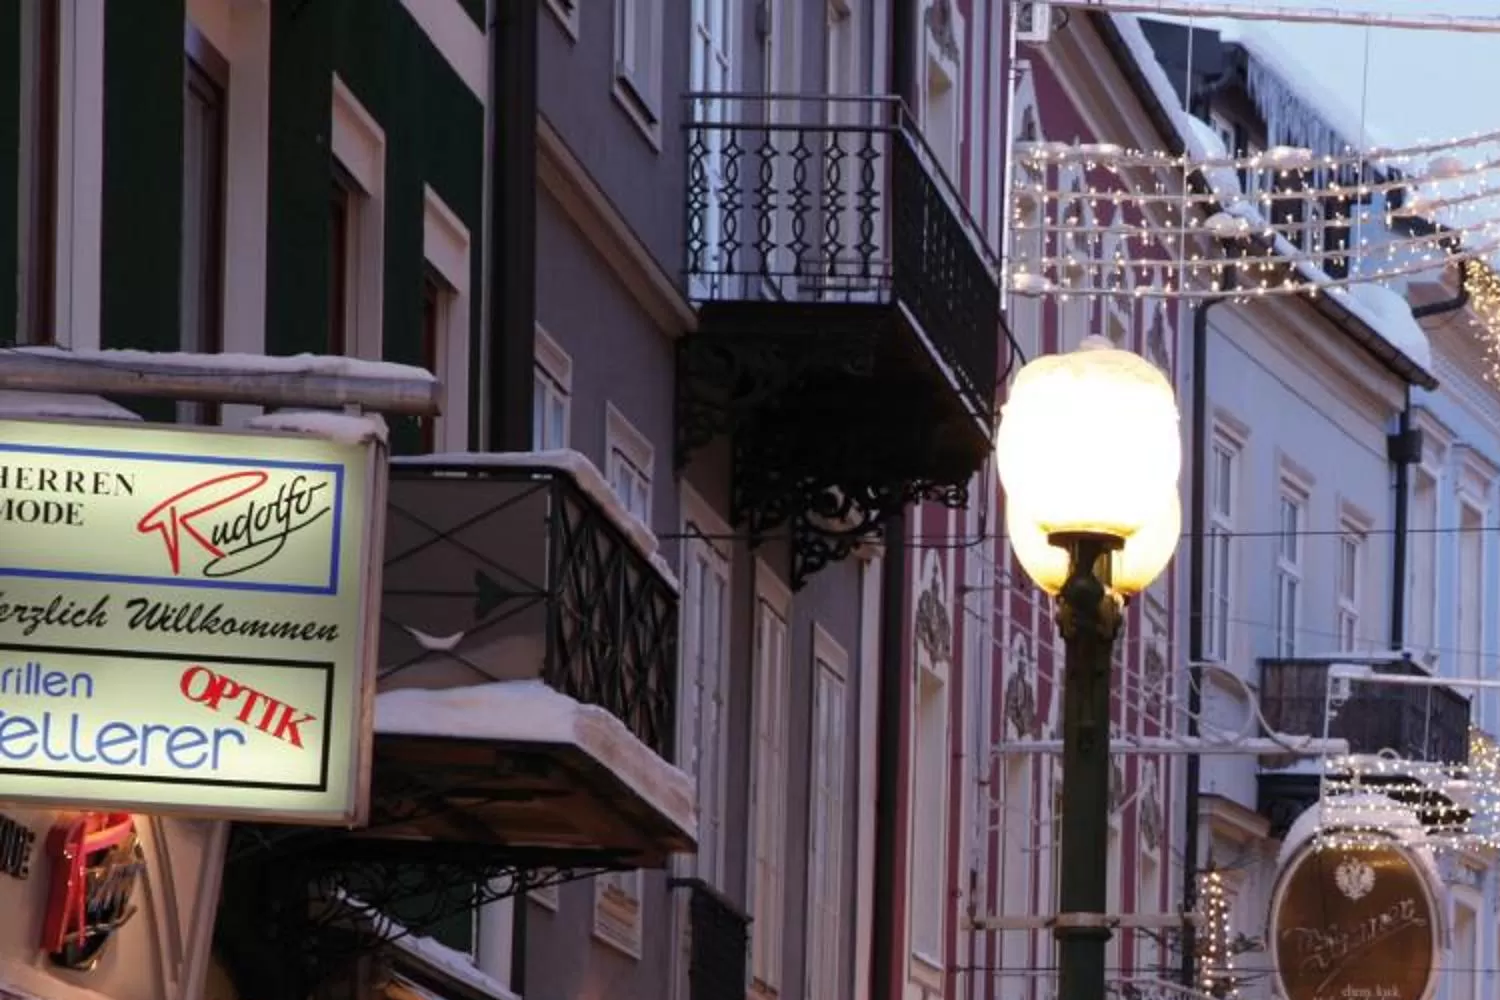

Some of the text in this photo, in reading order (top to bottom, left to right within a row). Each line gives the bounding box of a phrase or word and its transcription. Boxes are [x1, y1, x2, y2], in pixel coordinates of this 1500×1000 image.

[137, 470, 331, 577] Rudolfo
[0, 592, 340, 641] erzlich Willkommen
[0, 711, 246, 770] ellerer
[180, 664, 317, 749] OPTIK
